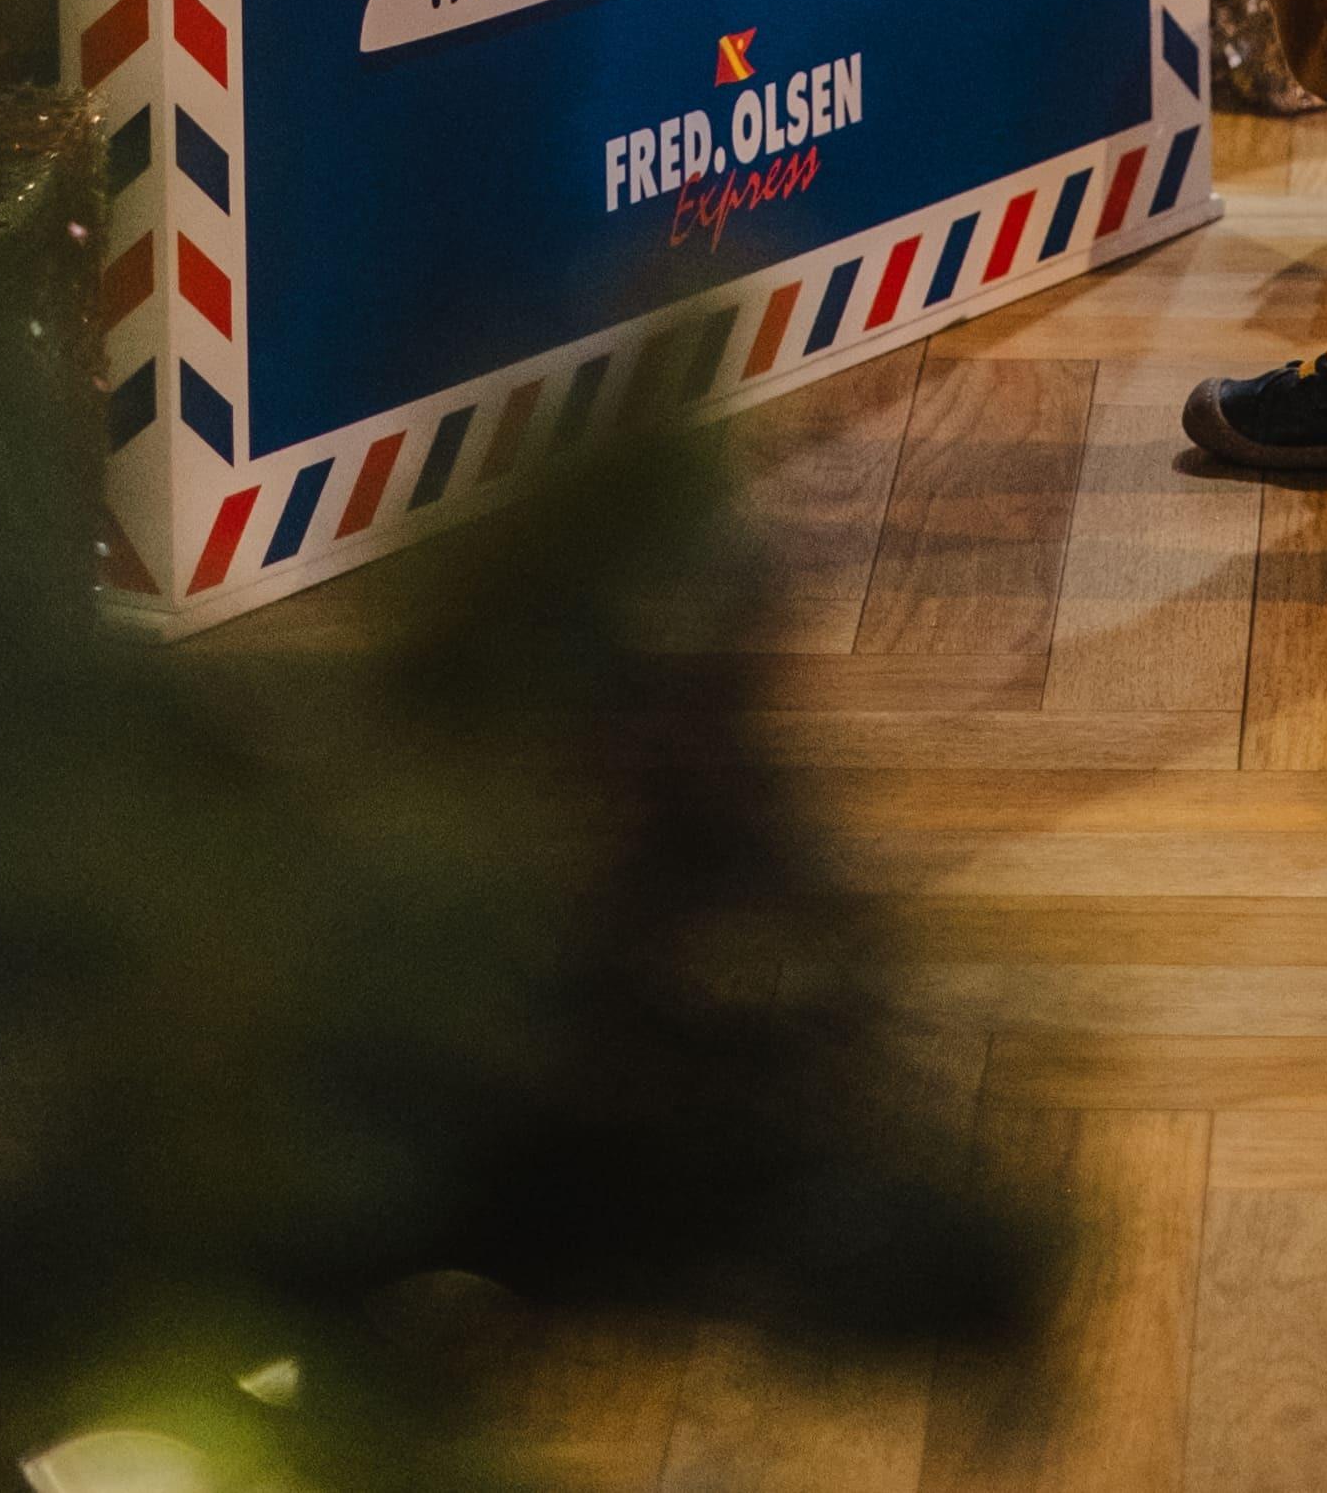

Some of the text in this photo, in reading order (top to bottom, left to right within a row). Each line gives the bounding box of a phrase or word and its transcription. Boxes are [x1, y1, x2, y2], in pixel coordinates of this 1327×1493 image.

[605, 52, 863, 213] FRED. OLSEN
[671, 145, 820, 253] Express
